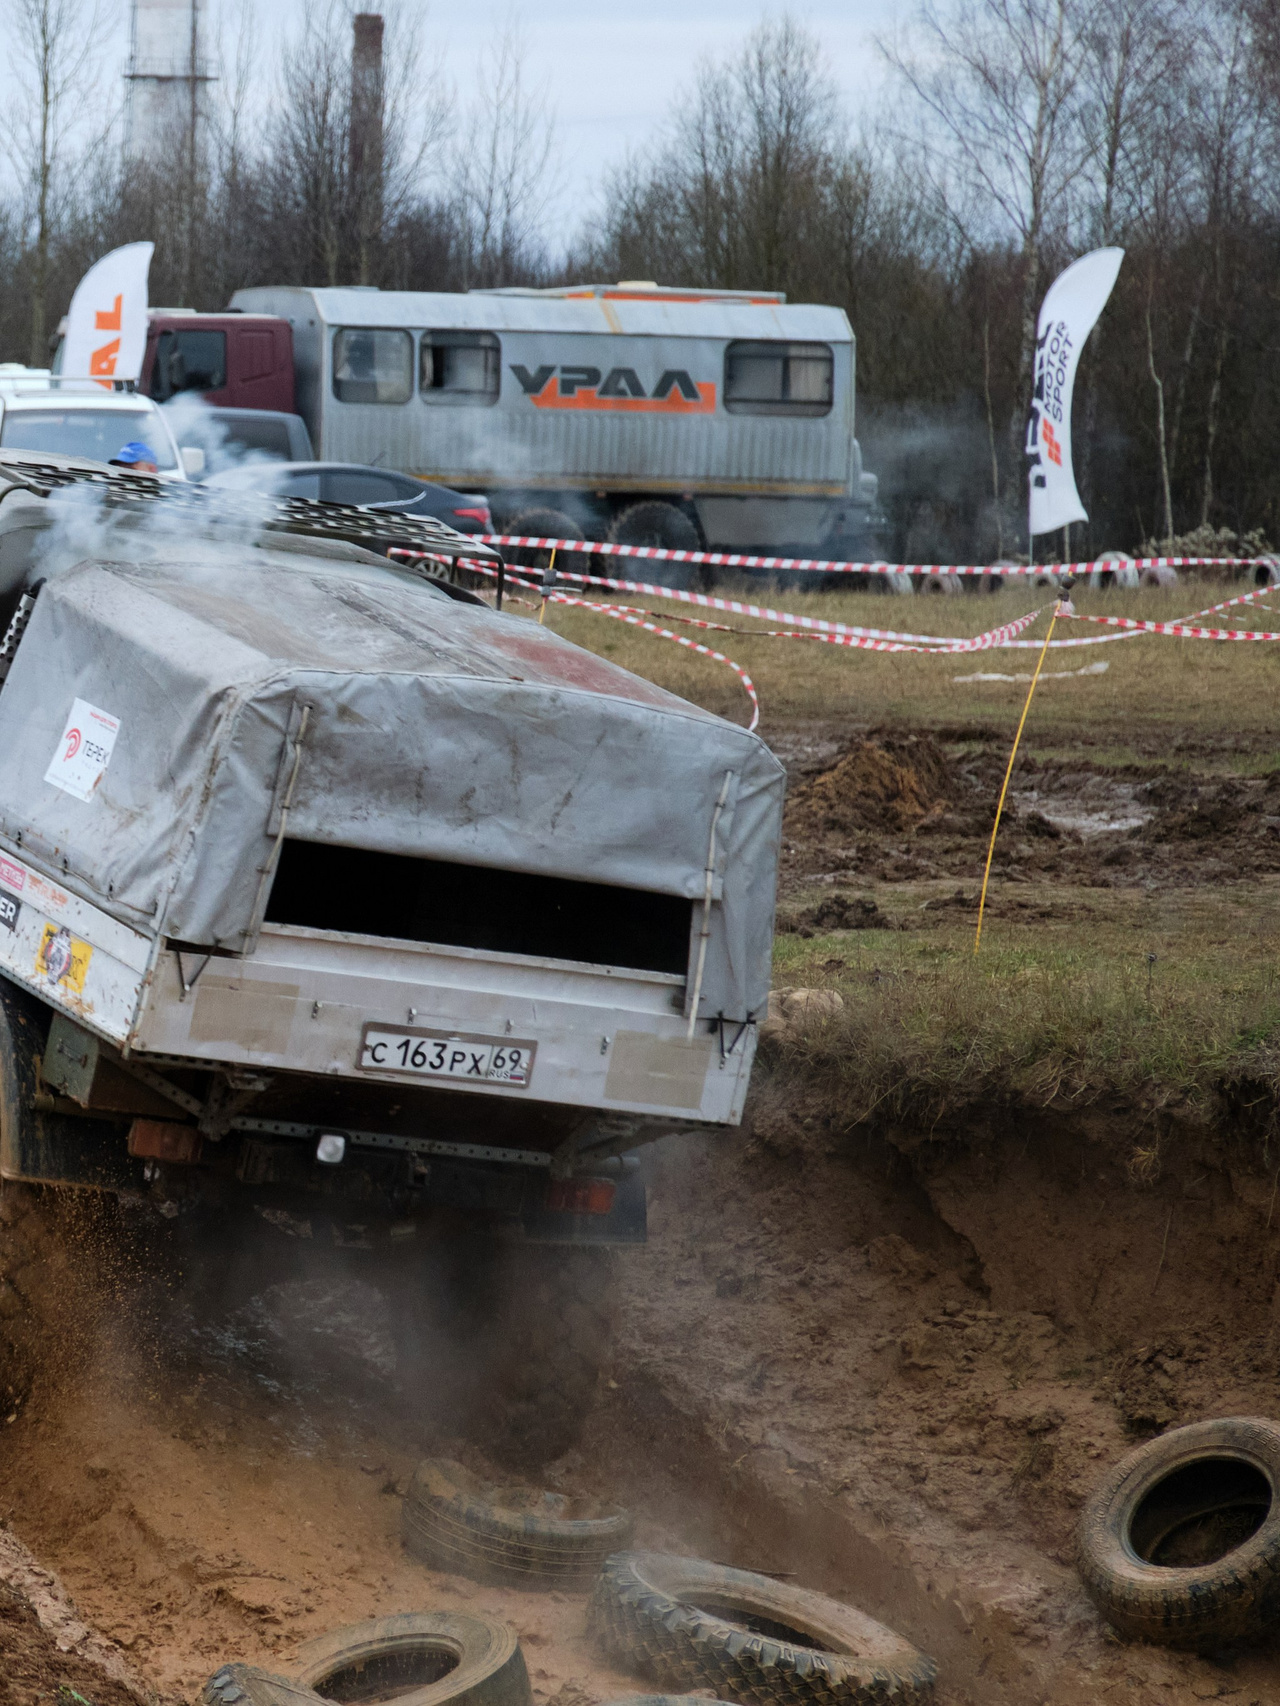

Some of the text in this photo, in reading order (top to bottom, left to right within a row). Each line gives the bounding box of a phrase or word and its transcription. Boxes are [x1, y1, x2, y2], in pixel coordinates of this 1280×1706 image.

[1044, 320, 1068, 414] MOTOR
[1051, 334, 1073, 424] SPORT
[489, 1070, 509, 1079] RUS
